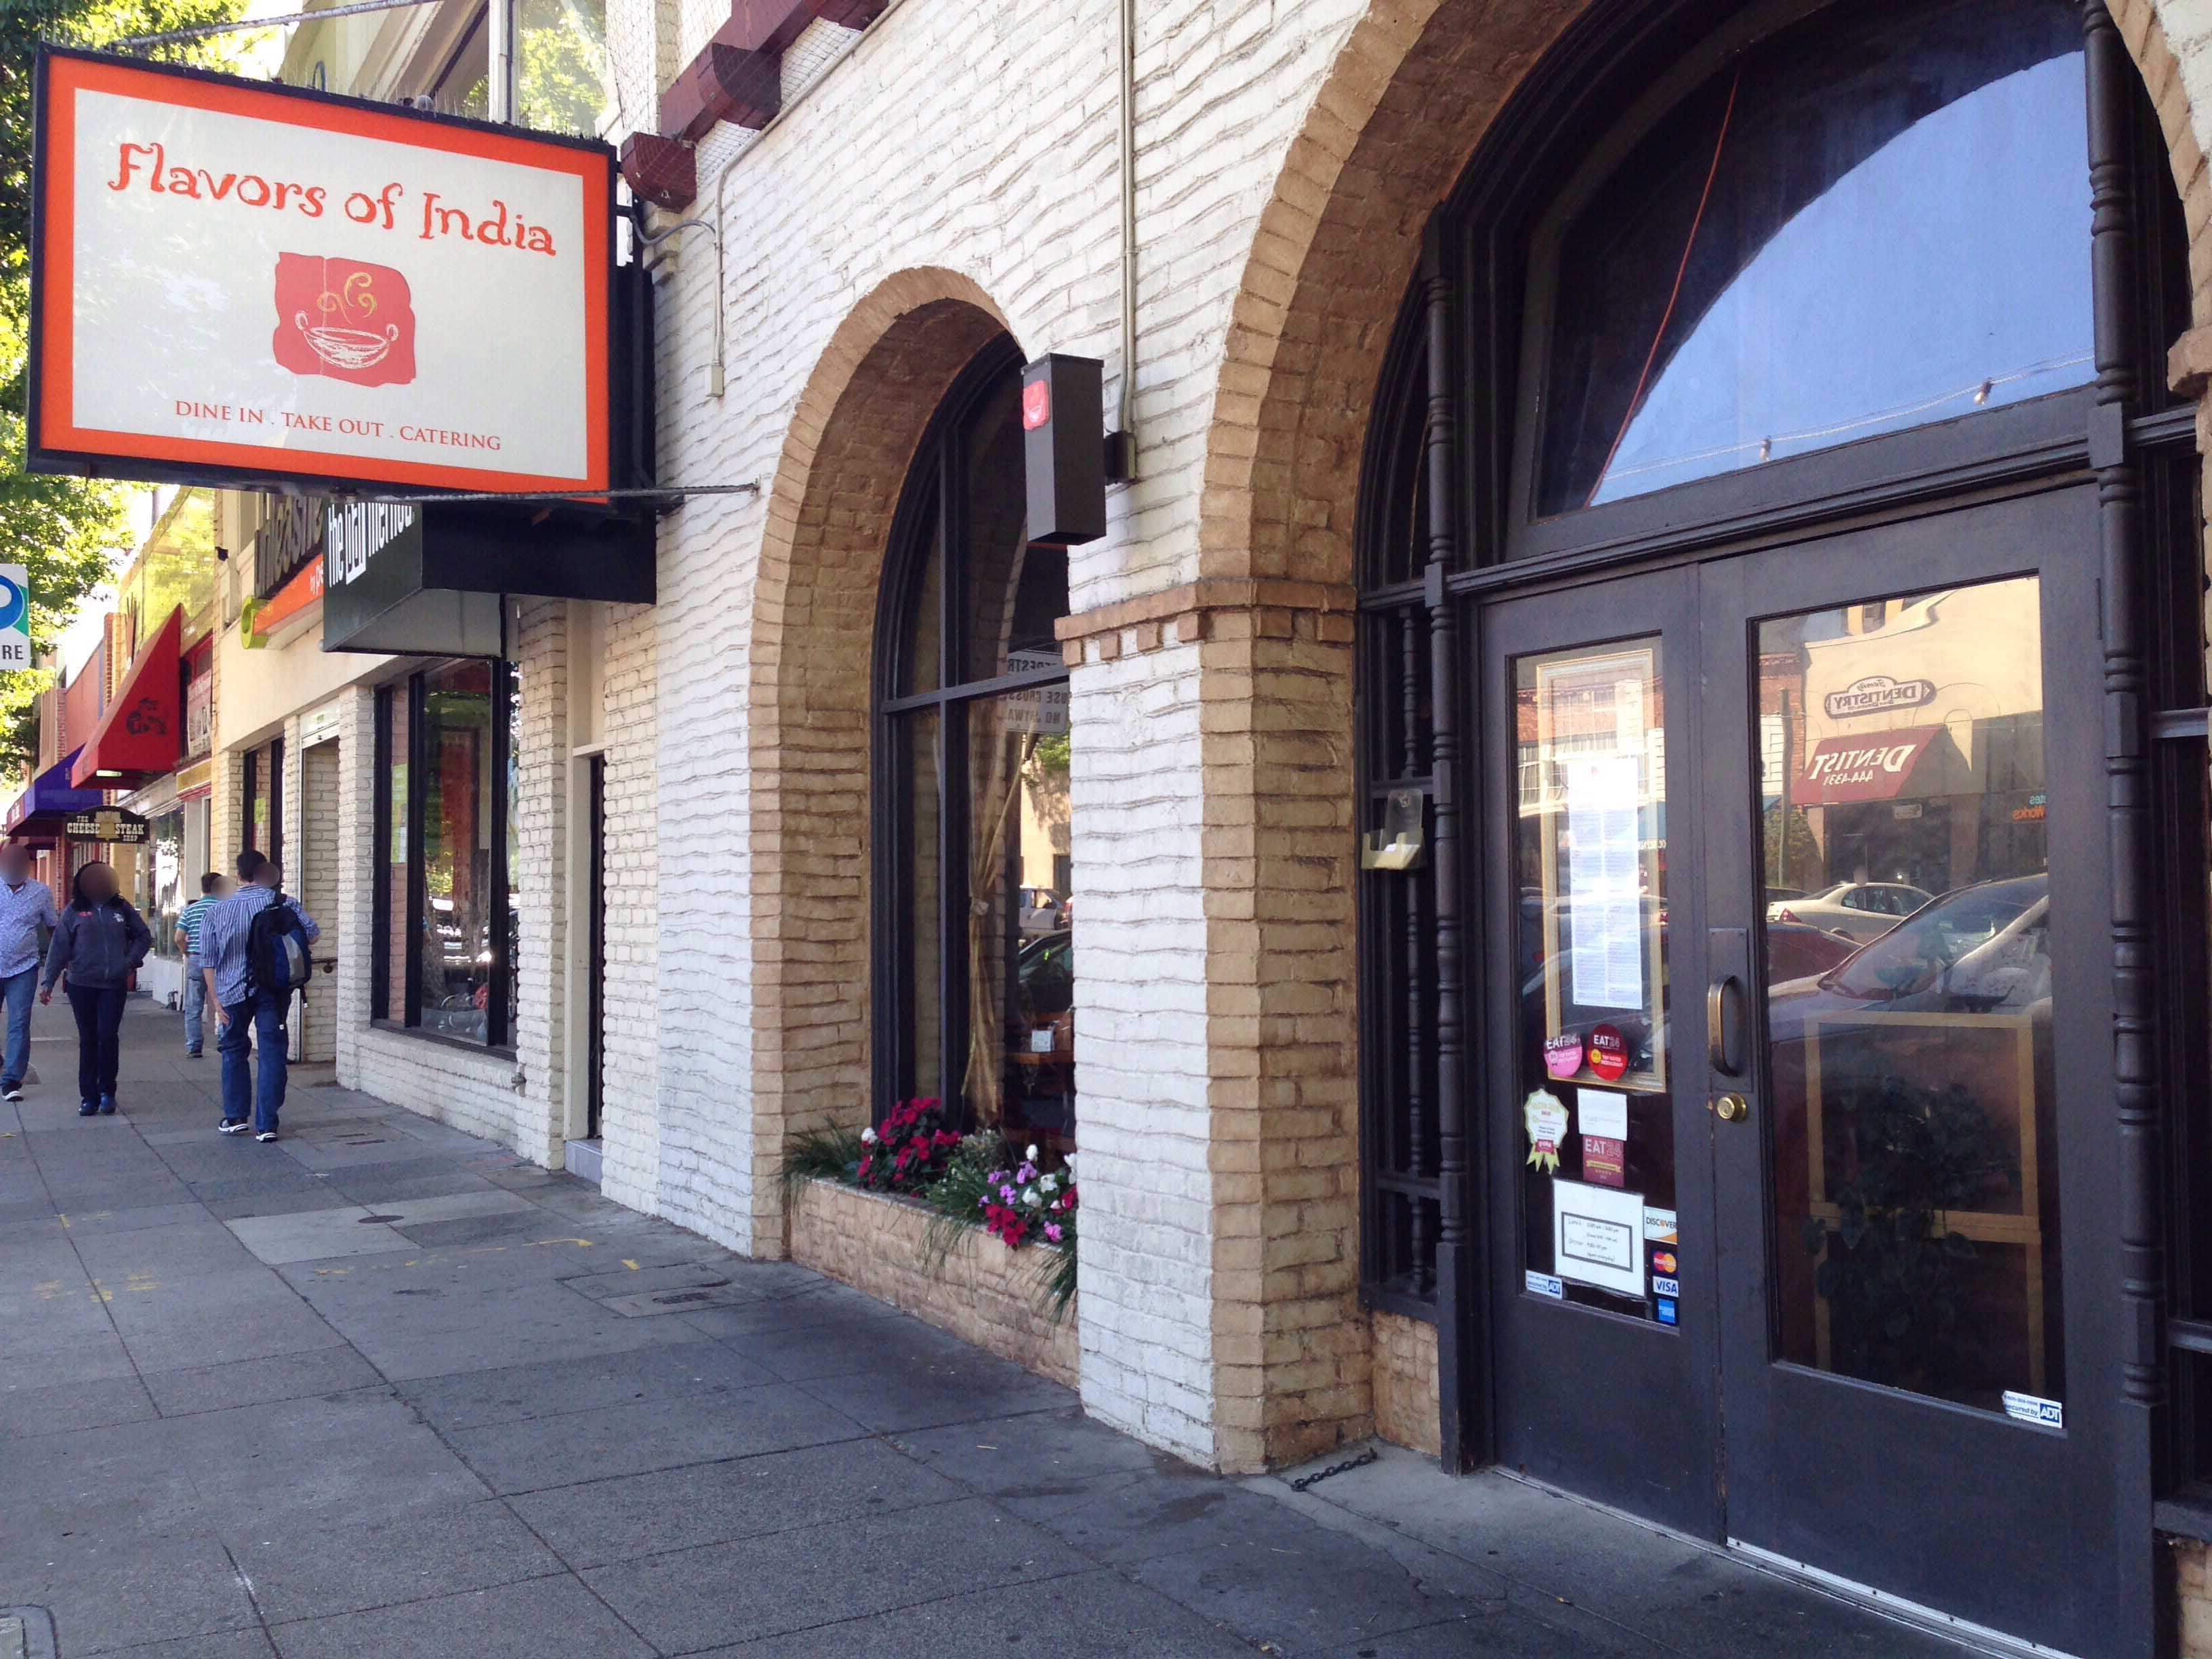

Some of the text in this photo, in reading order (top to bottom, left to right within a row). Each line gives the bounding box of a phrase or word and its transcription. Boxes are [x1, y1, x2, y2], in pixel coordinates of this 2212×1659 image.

[108, 142, 557, 257] Flavors of India
[174, 400, 232, 424] DINE
[281, 411, 333, 433] TAKE
[400, 425, 502, 451] CATERING
[328, 504, 344, 588] the
[2, 644, 24, 659] RE
[66, 822, 144, 835] CHEESE STEAK
[1584, 1138, 1622, 1158] EAT24
[1656, 1281, 1677, 1294] VISA
[2041, 1406, 2059, 1421] ADT
